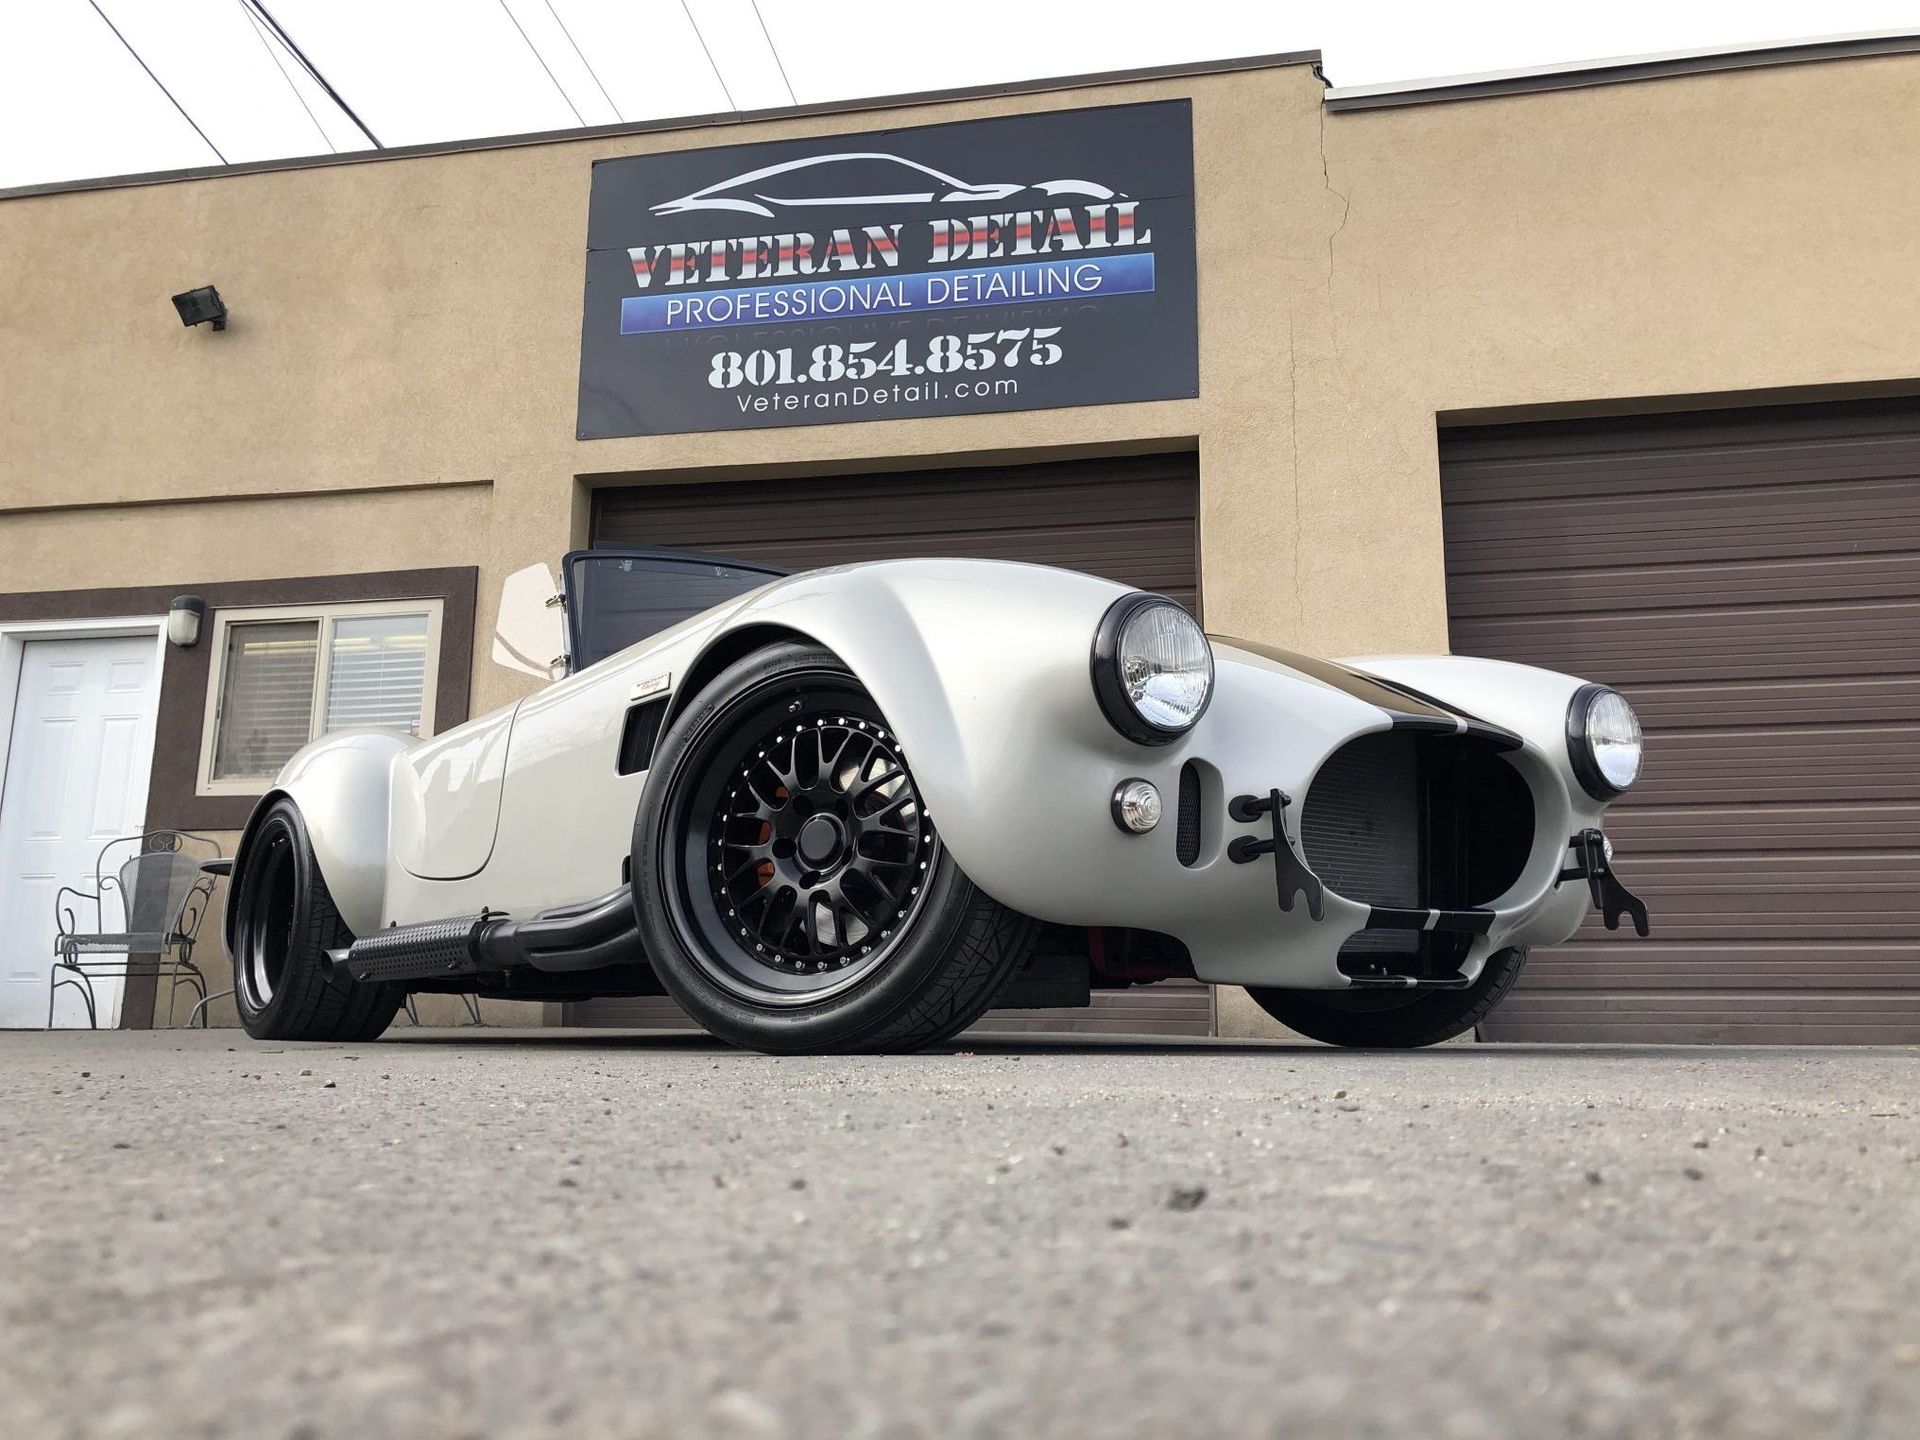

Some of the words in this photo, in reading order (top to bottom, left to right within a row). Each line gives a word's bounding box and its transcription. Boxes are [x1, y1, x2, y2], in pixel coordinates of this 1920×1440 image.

[627, 225, 902, 288] VETERAN
[928, 201, 1152, 264] DETAIL
[666, 282, 912, 325] PROFESSIONAL
[927, 264, 1102, 304] DETAILING
[708, 326, 1063, 389] 801.854.8575
[736, 376, 1018, 413] VeteranDetail.com
